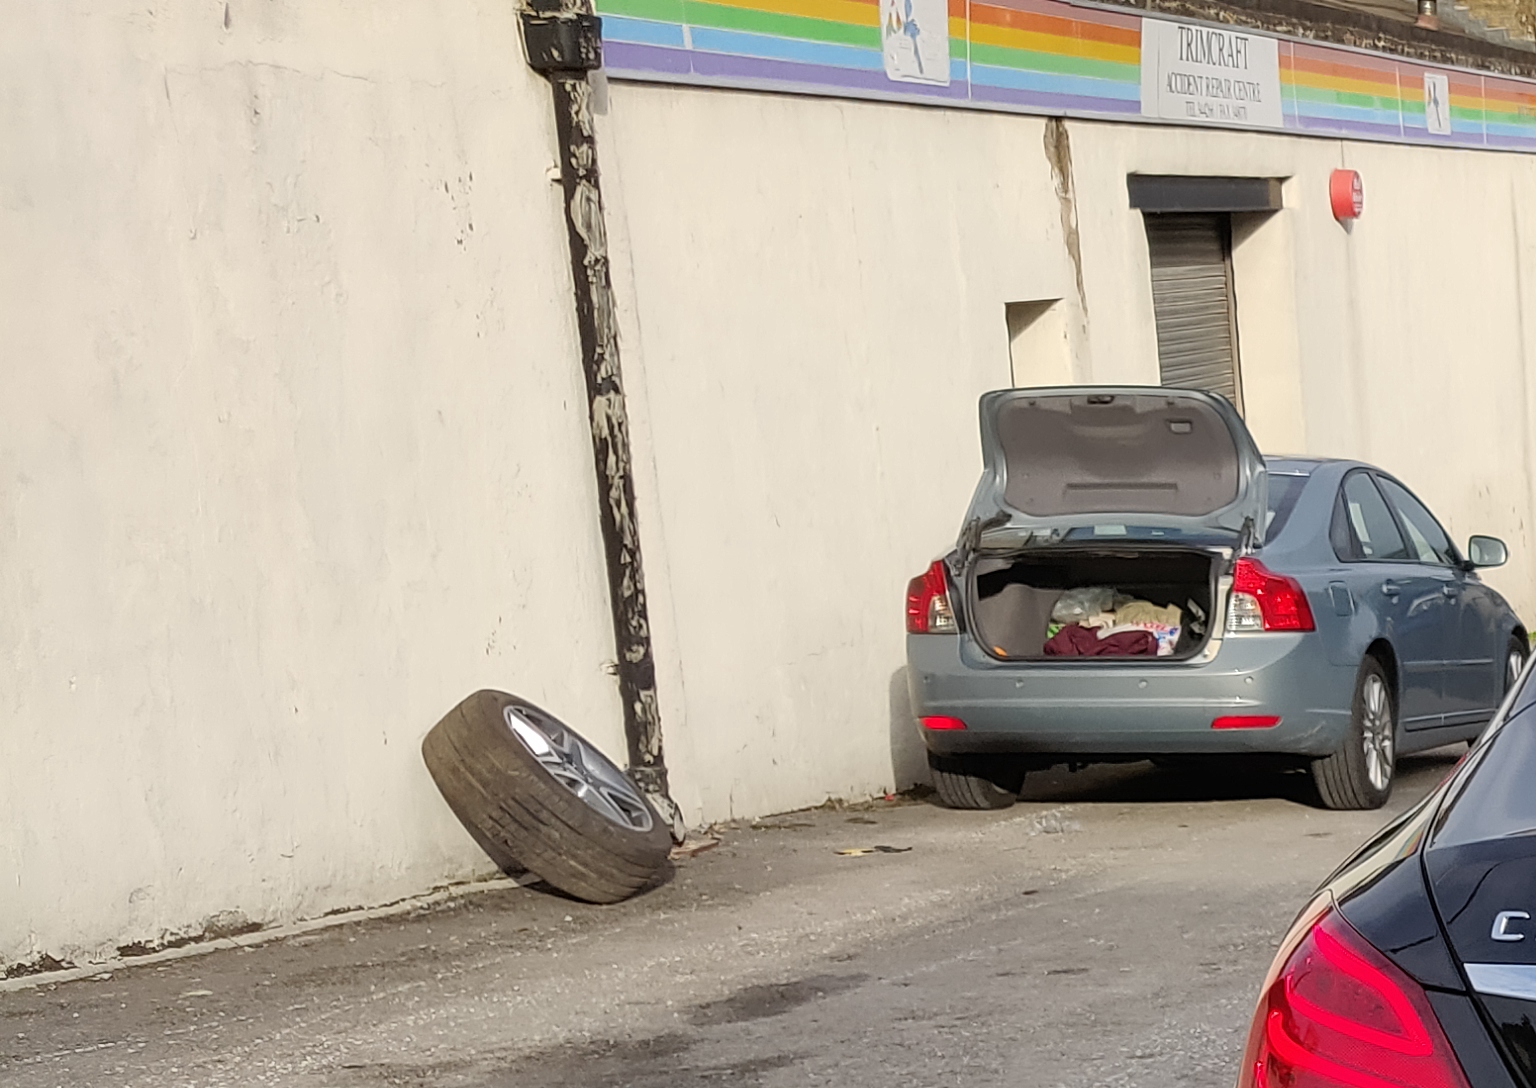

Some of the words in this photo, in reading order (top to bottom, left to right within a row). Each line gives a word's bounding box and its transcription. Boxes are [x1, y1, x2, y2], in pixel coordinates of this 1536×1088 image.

[1178, 26, 1248, 69] TRIMCRAFT
[1167, 72, 1203, 96] ACCIDENT
[1205, 77, 1232, 99] REPAIR
[1234, 80, 1261, 102] CENTRE
